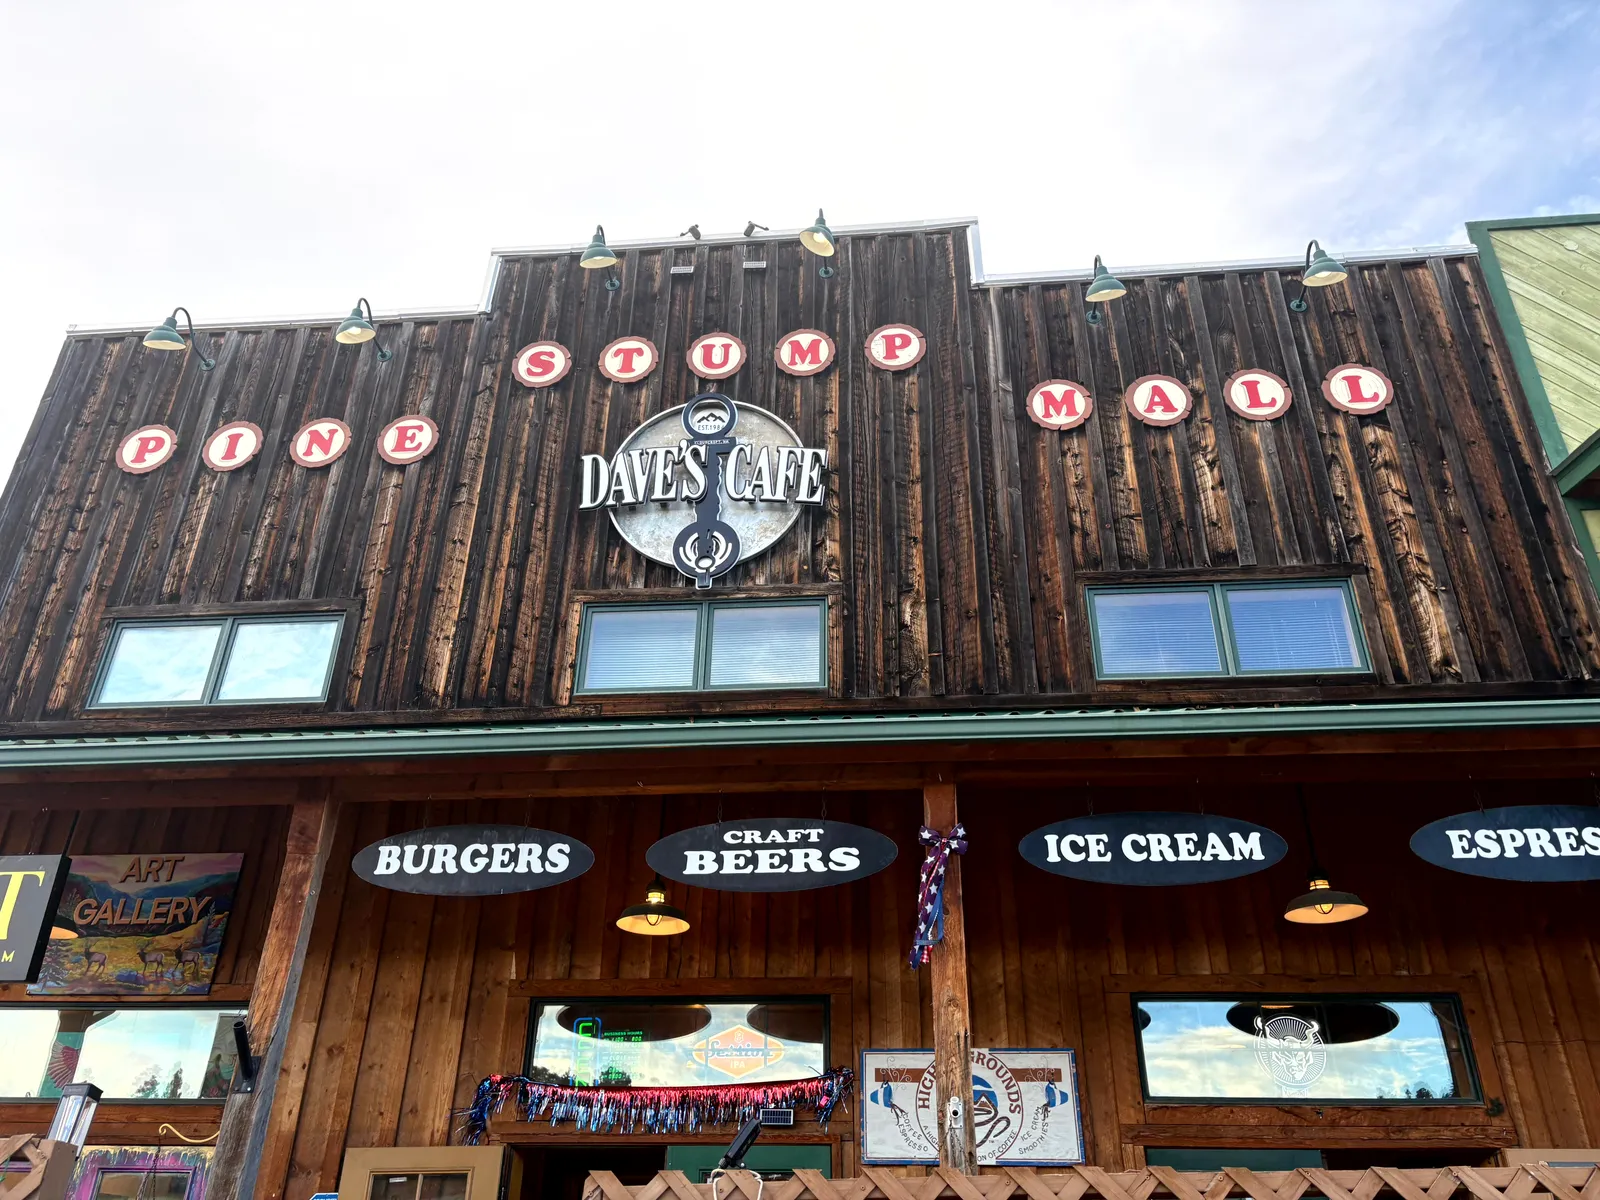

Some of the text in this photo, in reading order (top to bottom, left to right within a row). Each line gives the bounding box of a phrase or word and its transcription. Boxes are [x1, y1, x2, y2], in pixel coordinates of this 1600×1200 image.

[130, 333, 1380, 464] PINE STUMP MALL
[579, 440, 827, 510] DAVE'S CAFE
[723, 828, 825, 845] CRAFT
[1043, 831, 1266, 863] ICE CREAM
[118, 855, 186, 884] ART
[373, 842, 571, 876] BURGERS
[683, 847, 861, 875] BEERS
[73, 896, 212, 926] GALLERY
[730, 1060, 746, 1069] IPA
